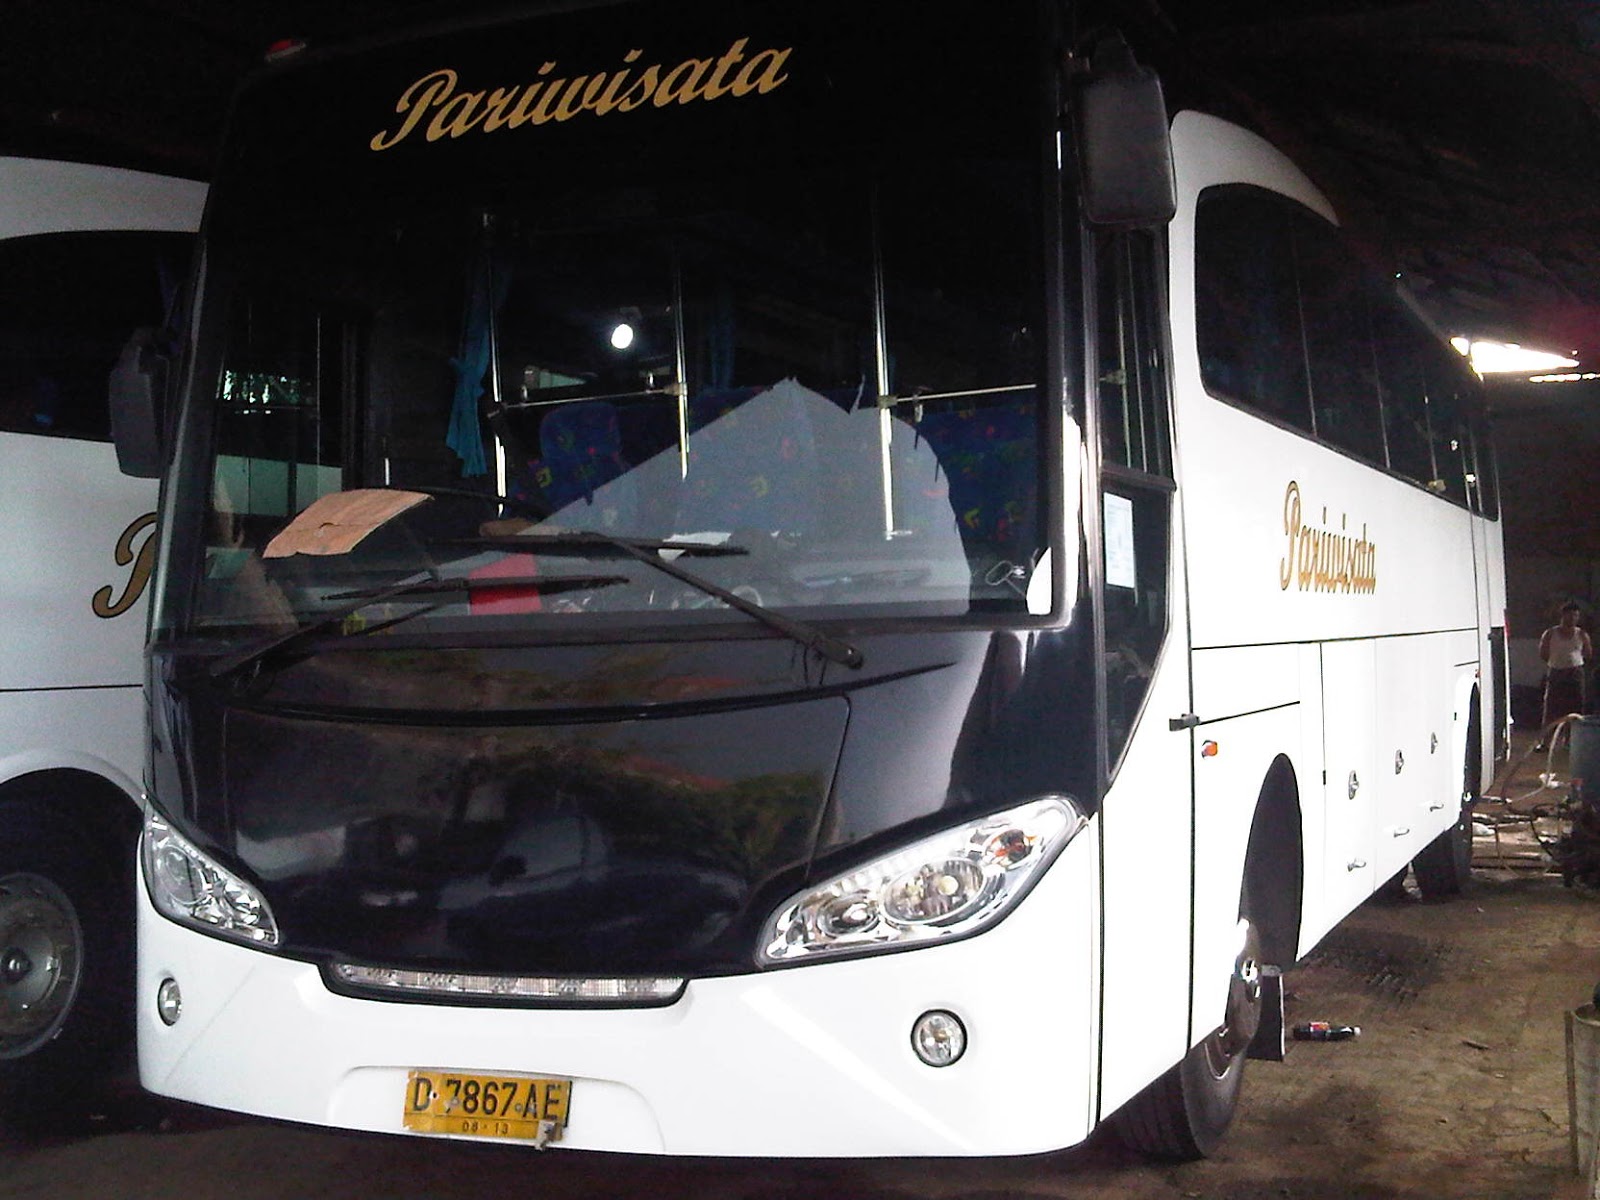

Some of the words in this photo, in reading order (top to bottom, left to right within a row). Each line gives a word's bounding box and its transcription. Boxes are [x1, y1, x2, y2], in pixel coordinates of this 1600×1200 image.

[370, 36, 793, 151] Pariwisata
[1280, 480, 1376, 594] Pariwisata
[412, 1077, 432, 1112] D
[446, 1079, 518, 1116] 7867
[522, 1083, 561, 1120] AE
